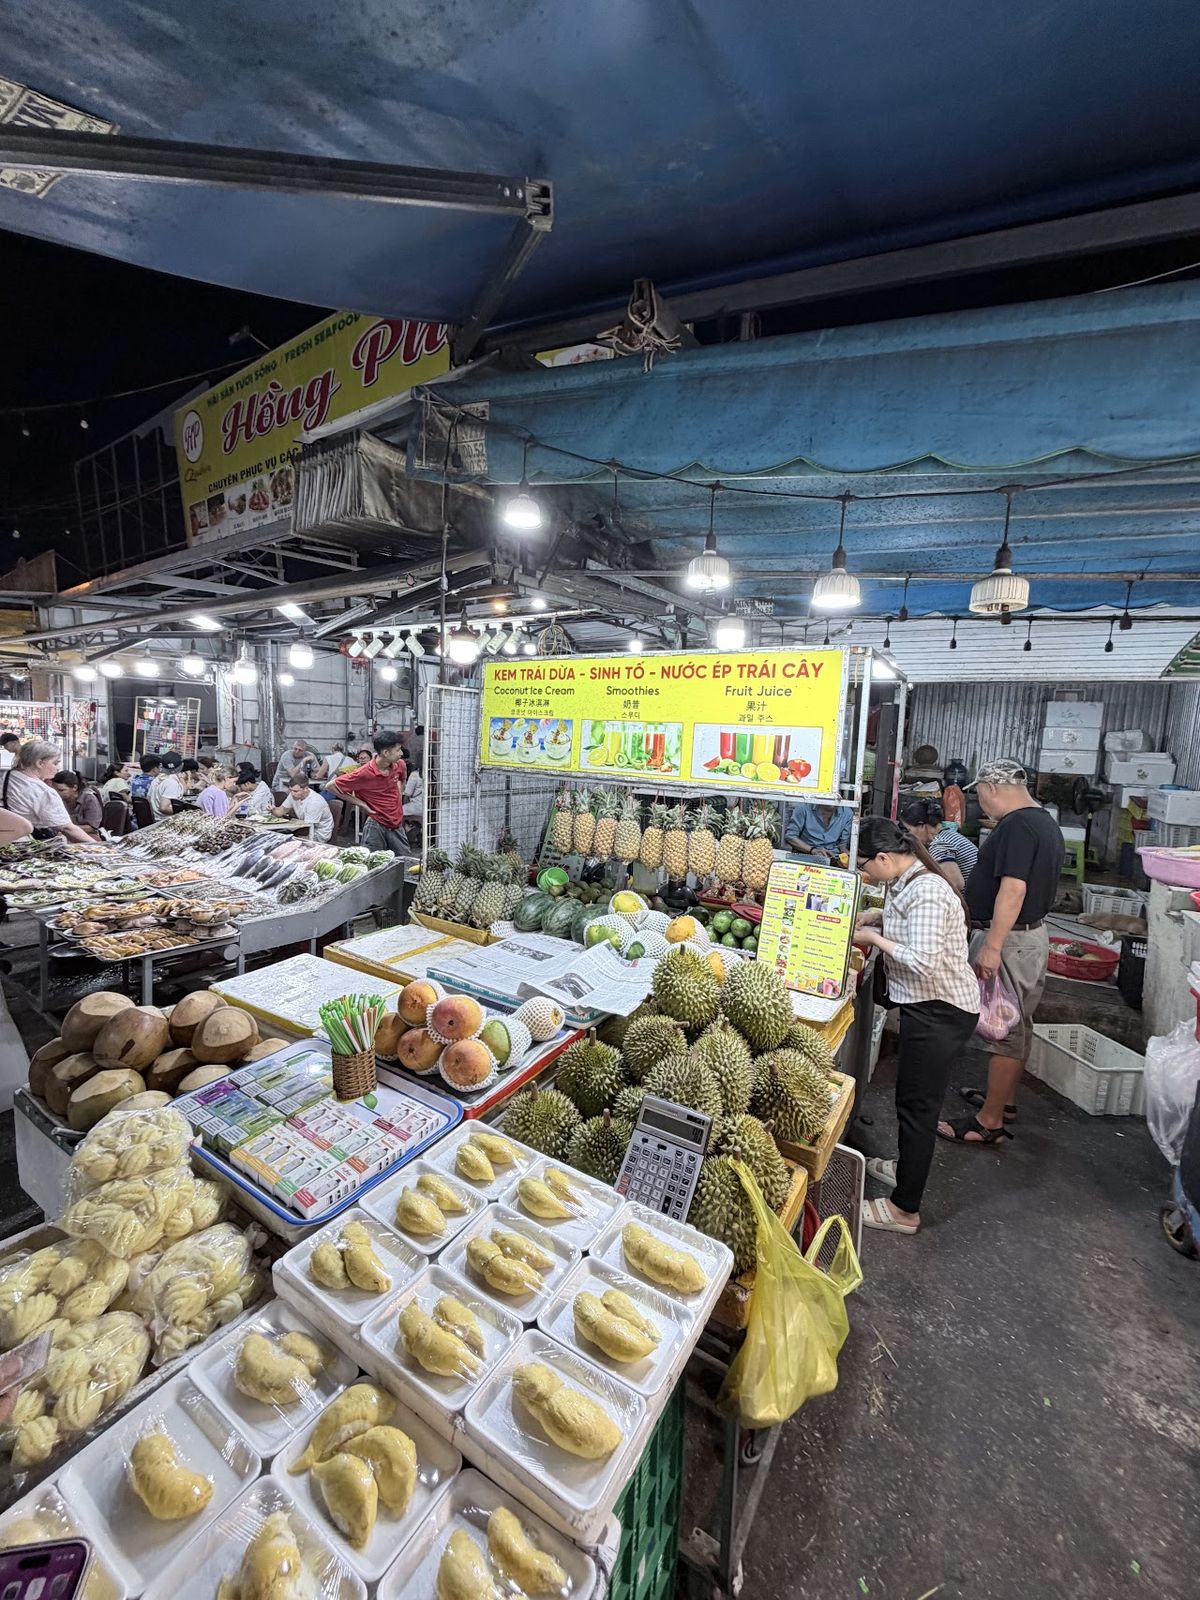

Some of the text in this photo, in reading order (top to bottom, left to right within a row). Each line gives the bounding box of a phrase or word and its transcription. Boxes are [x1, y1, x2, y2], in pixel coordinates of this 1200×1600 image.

[284, 339, 313, 363] FRESH
[221, 380, 342, 456] Hồng
[208, 472, 240, 495] CHUYÊN
[241, 463, 264, 484] PHỤC
[265, 454, 278, 471] VỤ
[494, 669, 517, 681] KEM
[520, 665, 546, 681] TRÁI
[549, 664, 576, 681] DỪA
[590, 666, 621, 680] SINH
[625, 661, 645, 679] TỐ
[661, 661, 707, 679] NƯỚC
[712, 660, 732, 678] ÉP
[737, 659, 776, 678] TRÁI
[782, 658, 824, 678] CÂY
[494, 686, 575, 696] Coconut Ice Cream
[606, 685, 660, 696] Smoothies
[725, 685, 792, 697] Fruit Juice
[746, 701, 768, 712] 果汁
